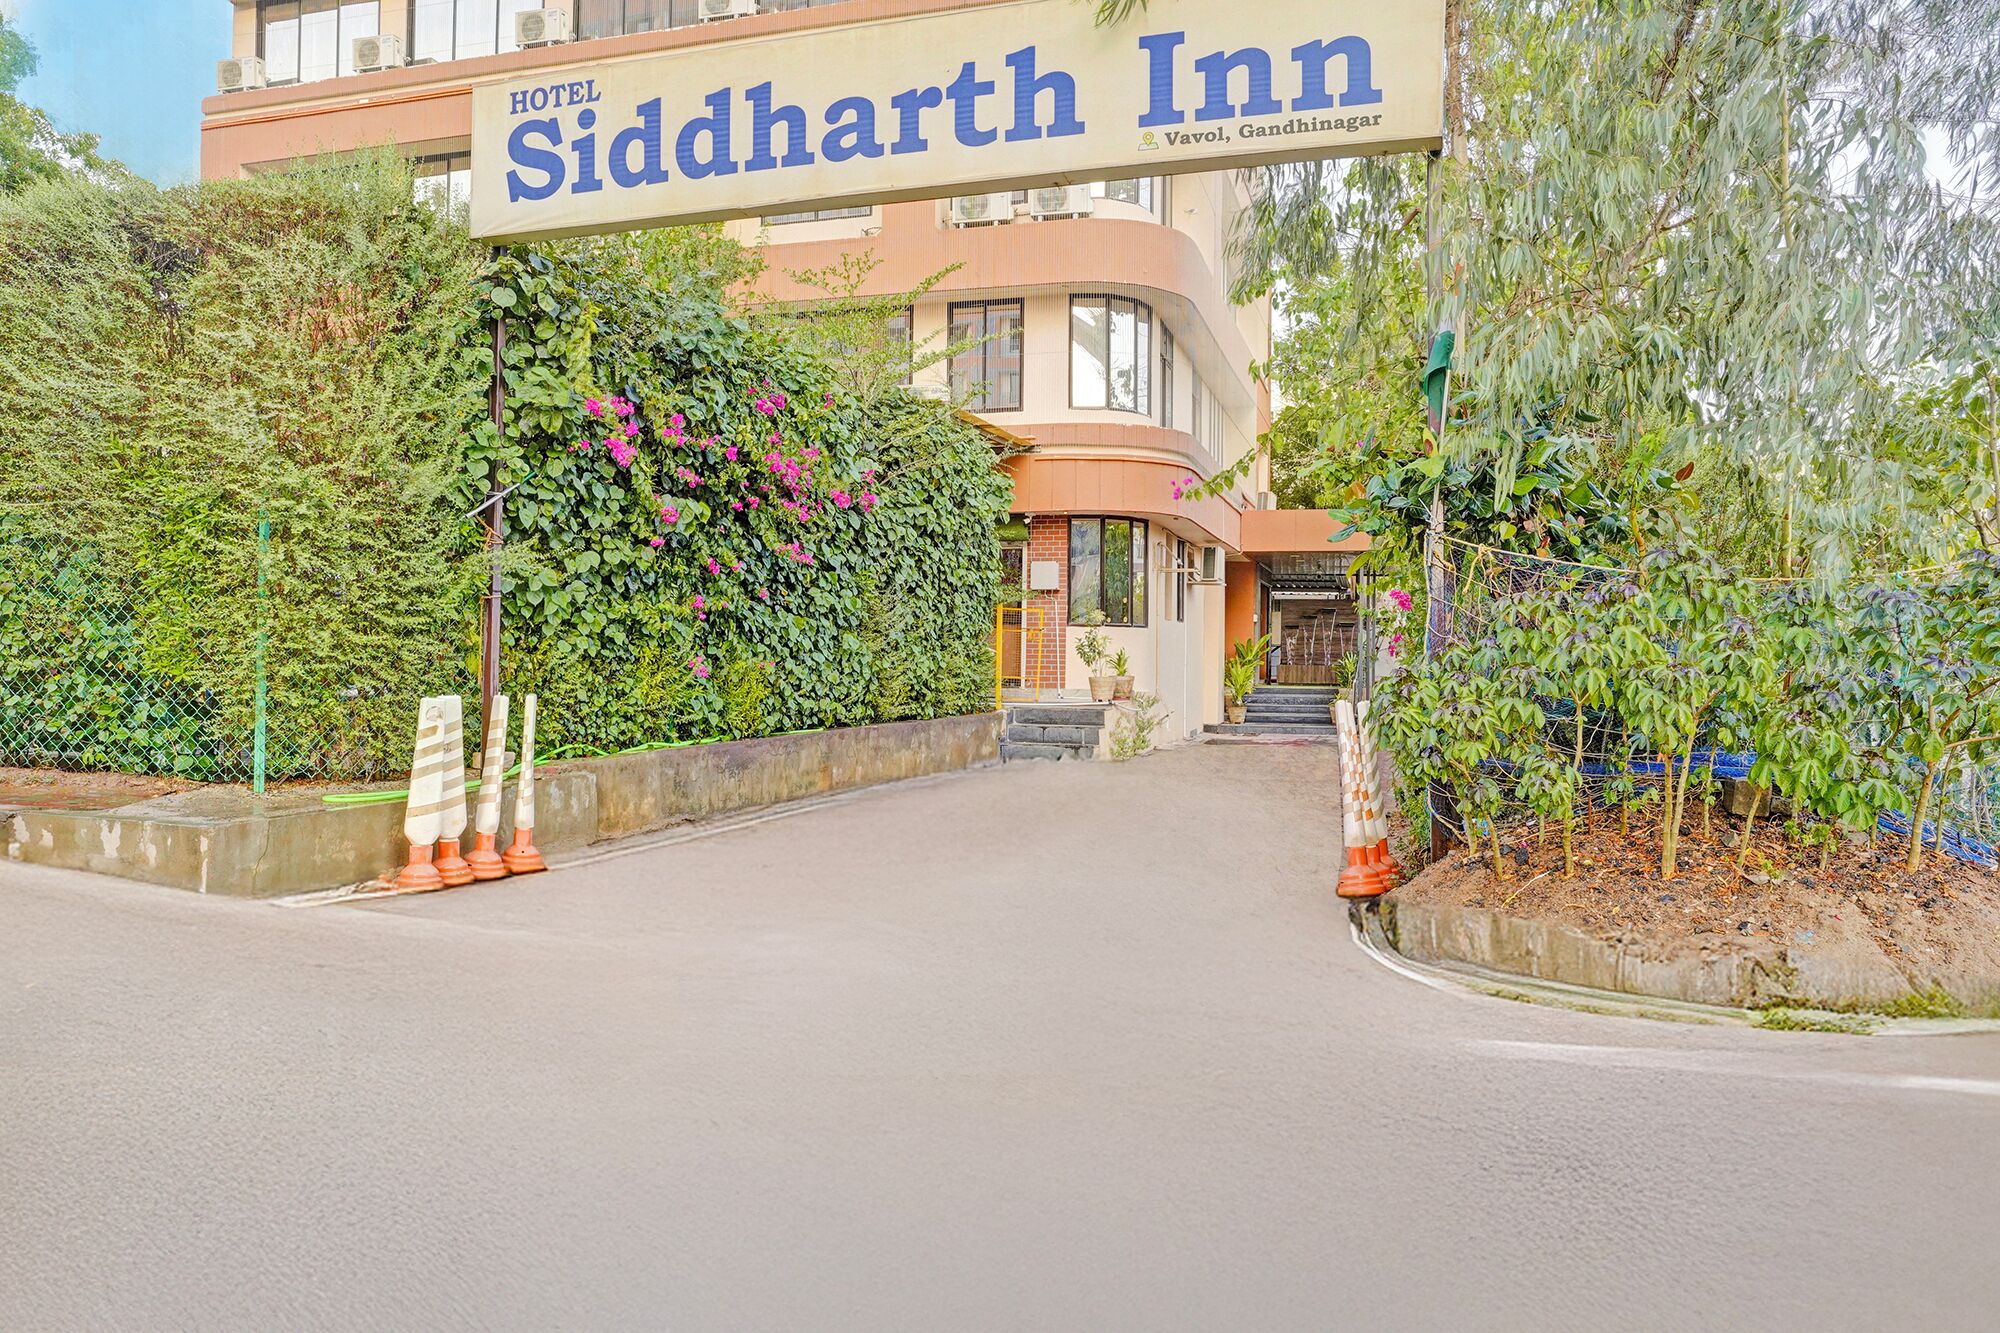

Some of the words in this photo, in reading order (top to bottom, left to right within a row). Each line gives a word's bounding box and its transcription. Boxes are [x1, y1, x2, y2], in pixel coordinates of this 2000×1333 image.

[510, 79, 602, 115] HOTEL
[507, 46, 1085, 202] Siddharth
[1139, 31, 1382, 128] Inn
[1164, 127, 1231, 146] Vavol,
[1239, 113, 1383, 139] Gandhinagar
